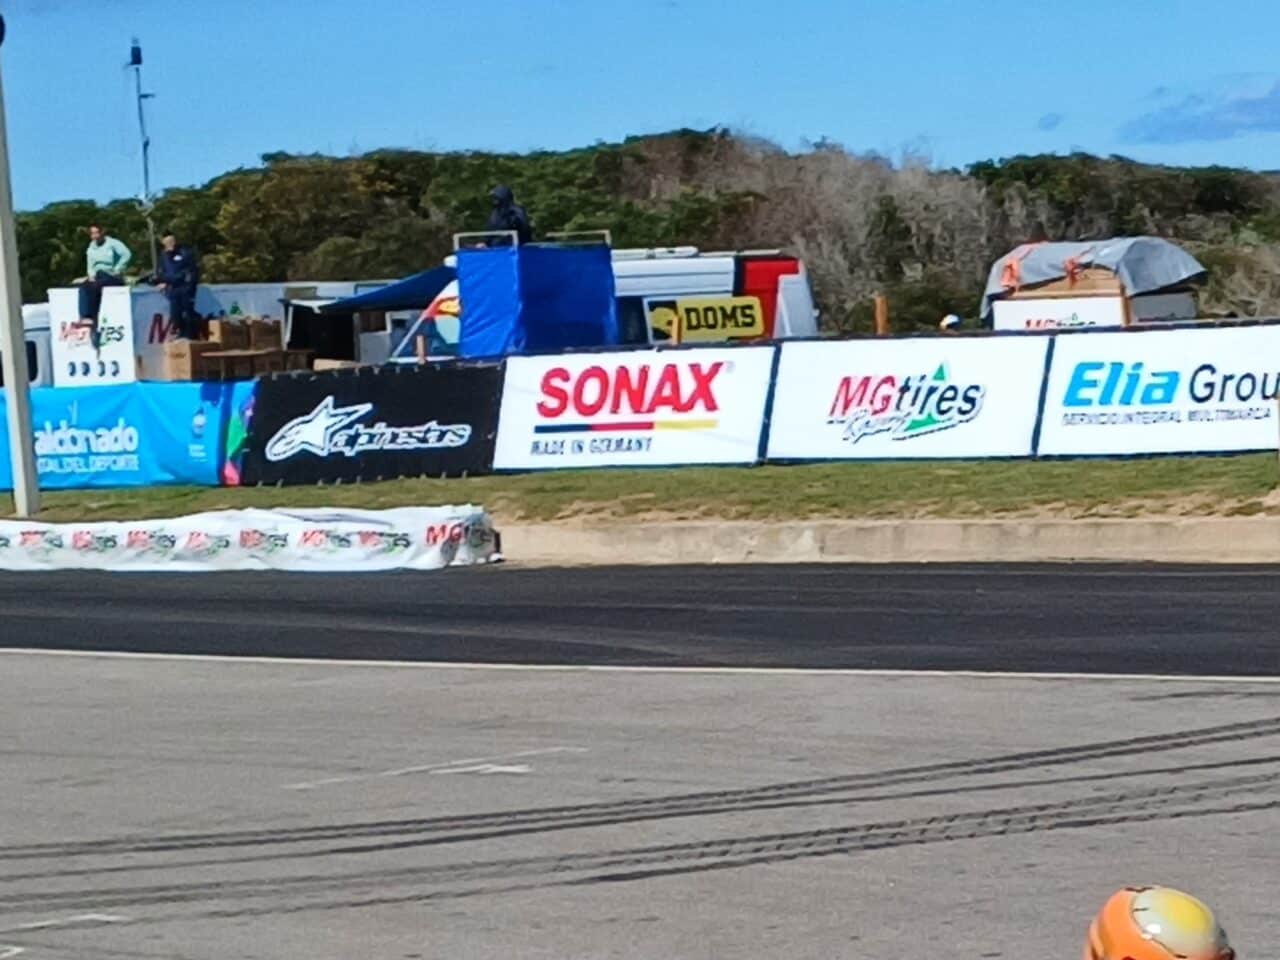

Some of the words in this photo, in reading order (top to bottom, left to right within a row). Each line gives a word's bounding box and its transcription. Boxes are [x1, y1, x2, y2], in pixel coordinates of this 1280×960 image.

[683, 304, 756, 331] DOMS
[536, 360, 725, 418] SONAX
[1063, 361, 1181, 407] Elia
[34, 417, 139, 456] aldonado
